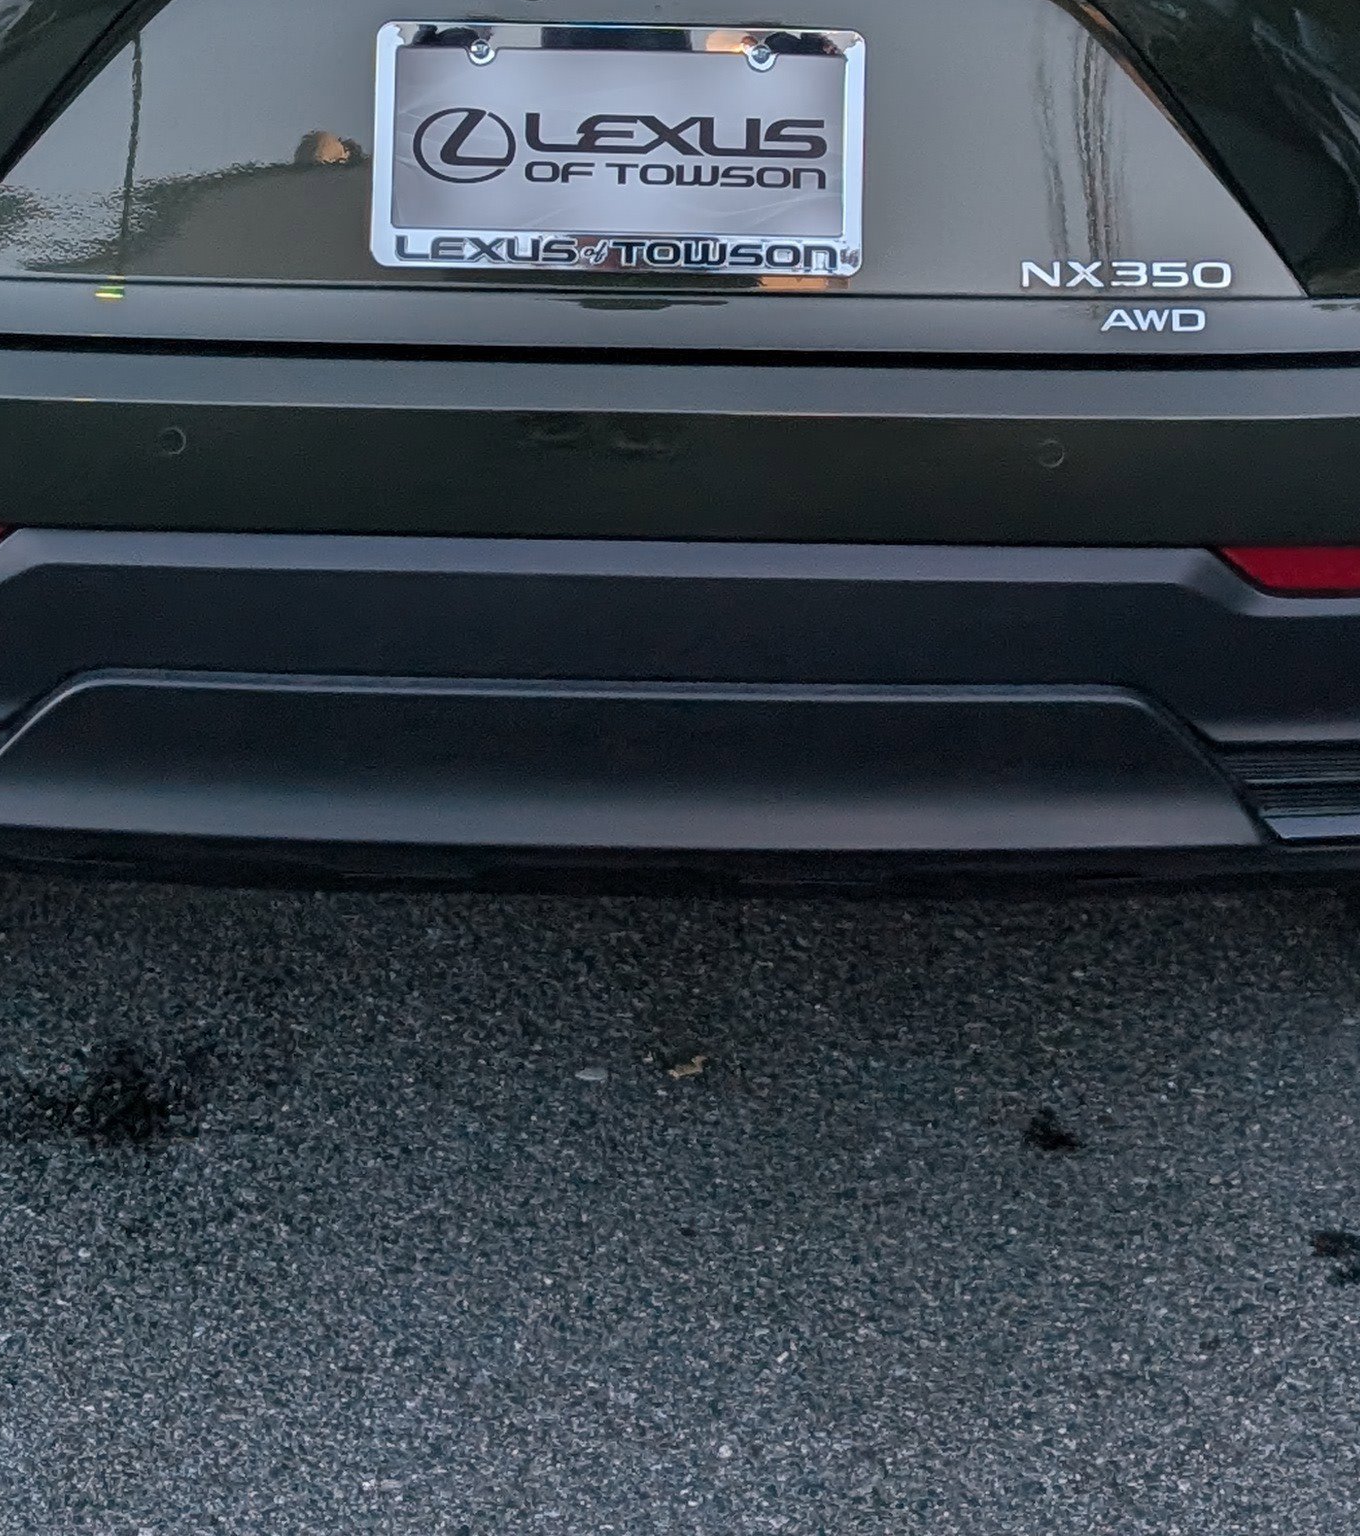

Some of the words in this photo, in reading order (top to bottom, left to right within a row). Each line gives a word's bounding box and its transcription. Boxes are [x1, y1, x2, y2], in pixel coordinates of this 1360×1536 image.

[524, 112, 828, 159] LEXUS
[524, 161, 594, 184] OF
[605, 164, 827, 190] TOWSON
[394, 234, 580, 263] LEXUS
[583, 240, 607, 263] of
[609, 238, 839, 269] TOWSON
[1100, 309, 1206, 332] AWD
